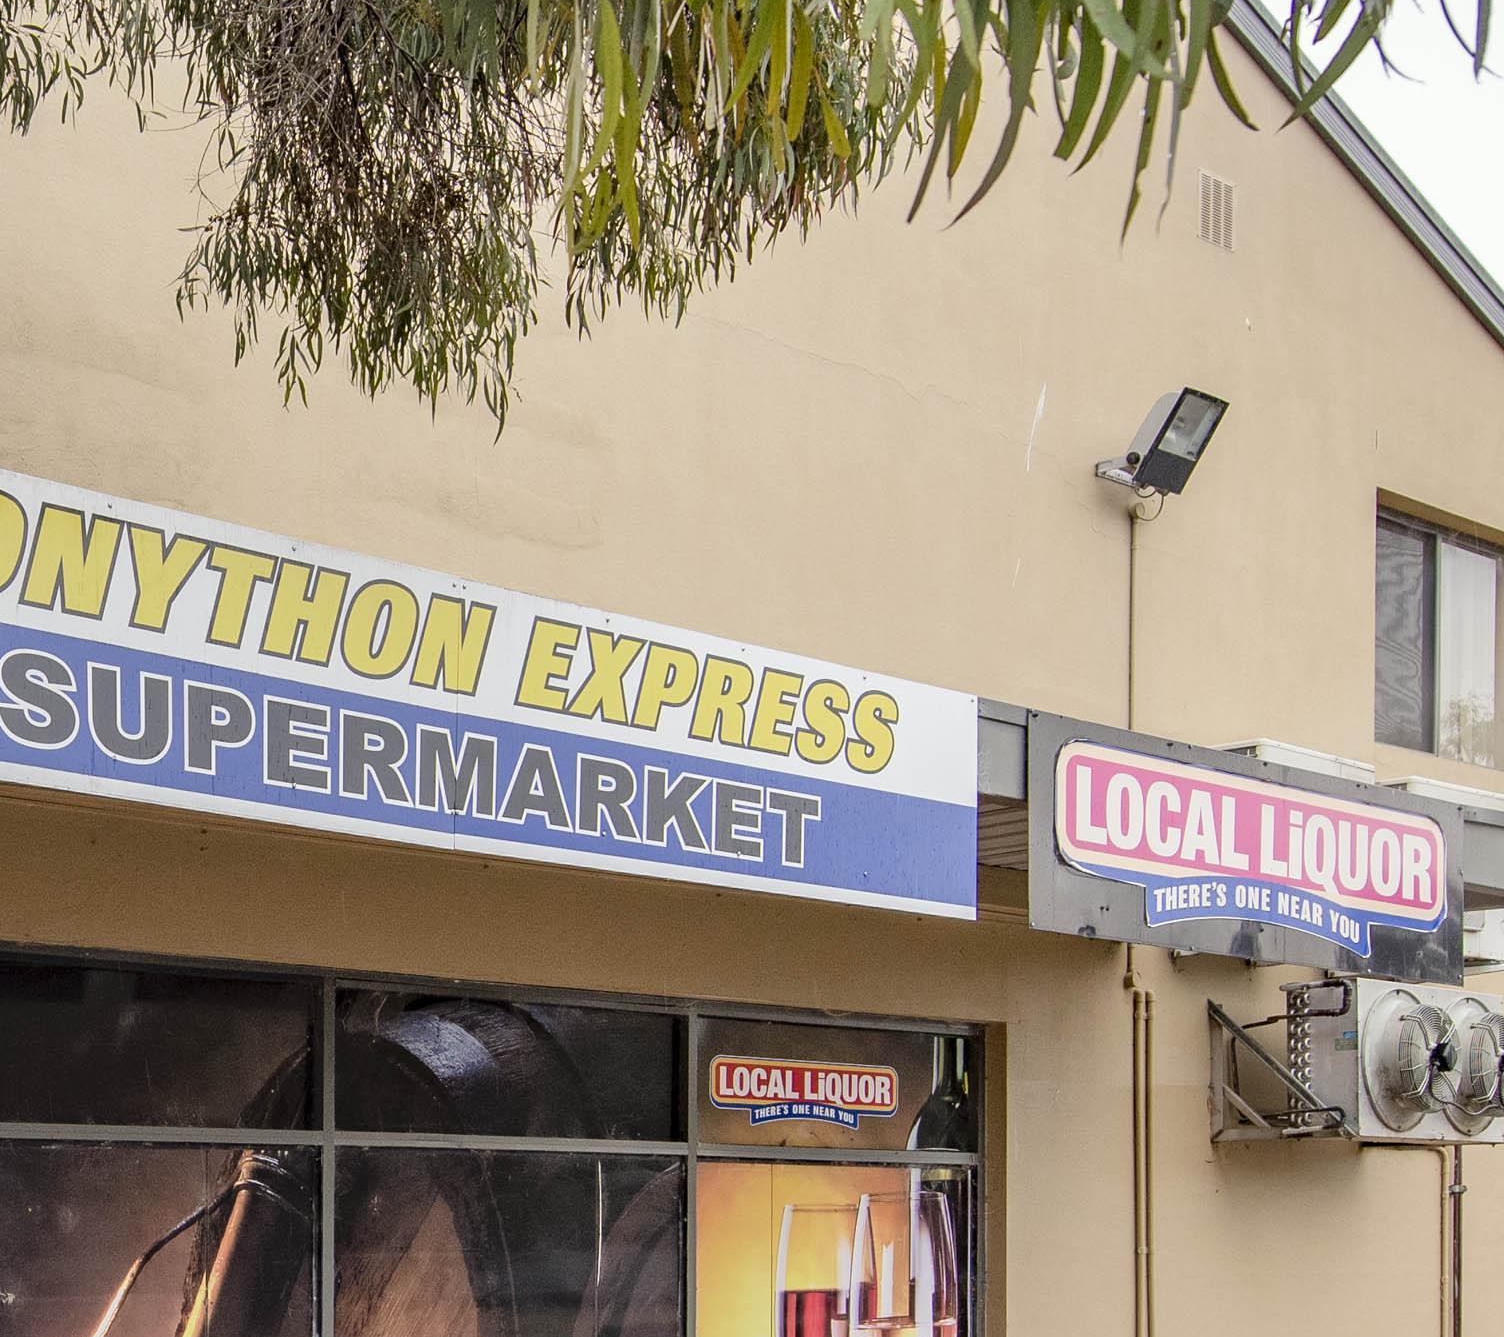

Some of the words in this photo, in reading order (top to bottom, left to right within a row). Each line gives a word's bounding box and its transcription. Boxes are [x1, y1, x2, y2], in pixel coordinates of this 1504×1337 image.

[515, 617, 898, 772] EXPRESS
[1075, 764, 1253, 871] LOCAL
[1154, 880, 1227, 913] THERE'S
[1235, 885, 1271, 912] ONE
[1277, 892, 1323, 927] NEAR
[1328, 905, 1360, 944] YOU
[719, 1065, 799, 1099] LOCAL
[754, 1104, 789, 1119] THERE'S
[792, 1104, 810, 1114] ONE
[813, 1106, 835, 1118] NEAR
[838, 1111, 854, 1124] YOU
